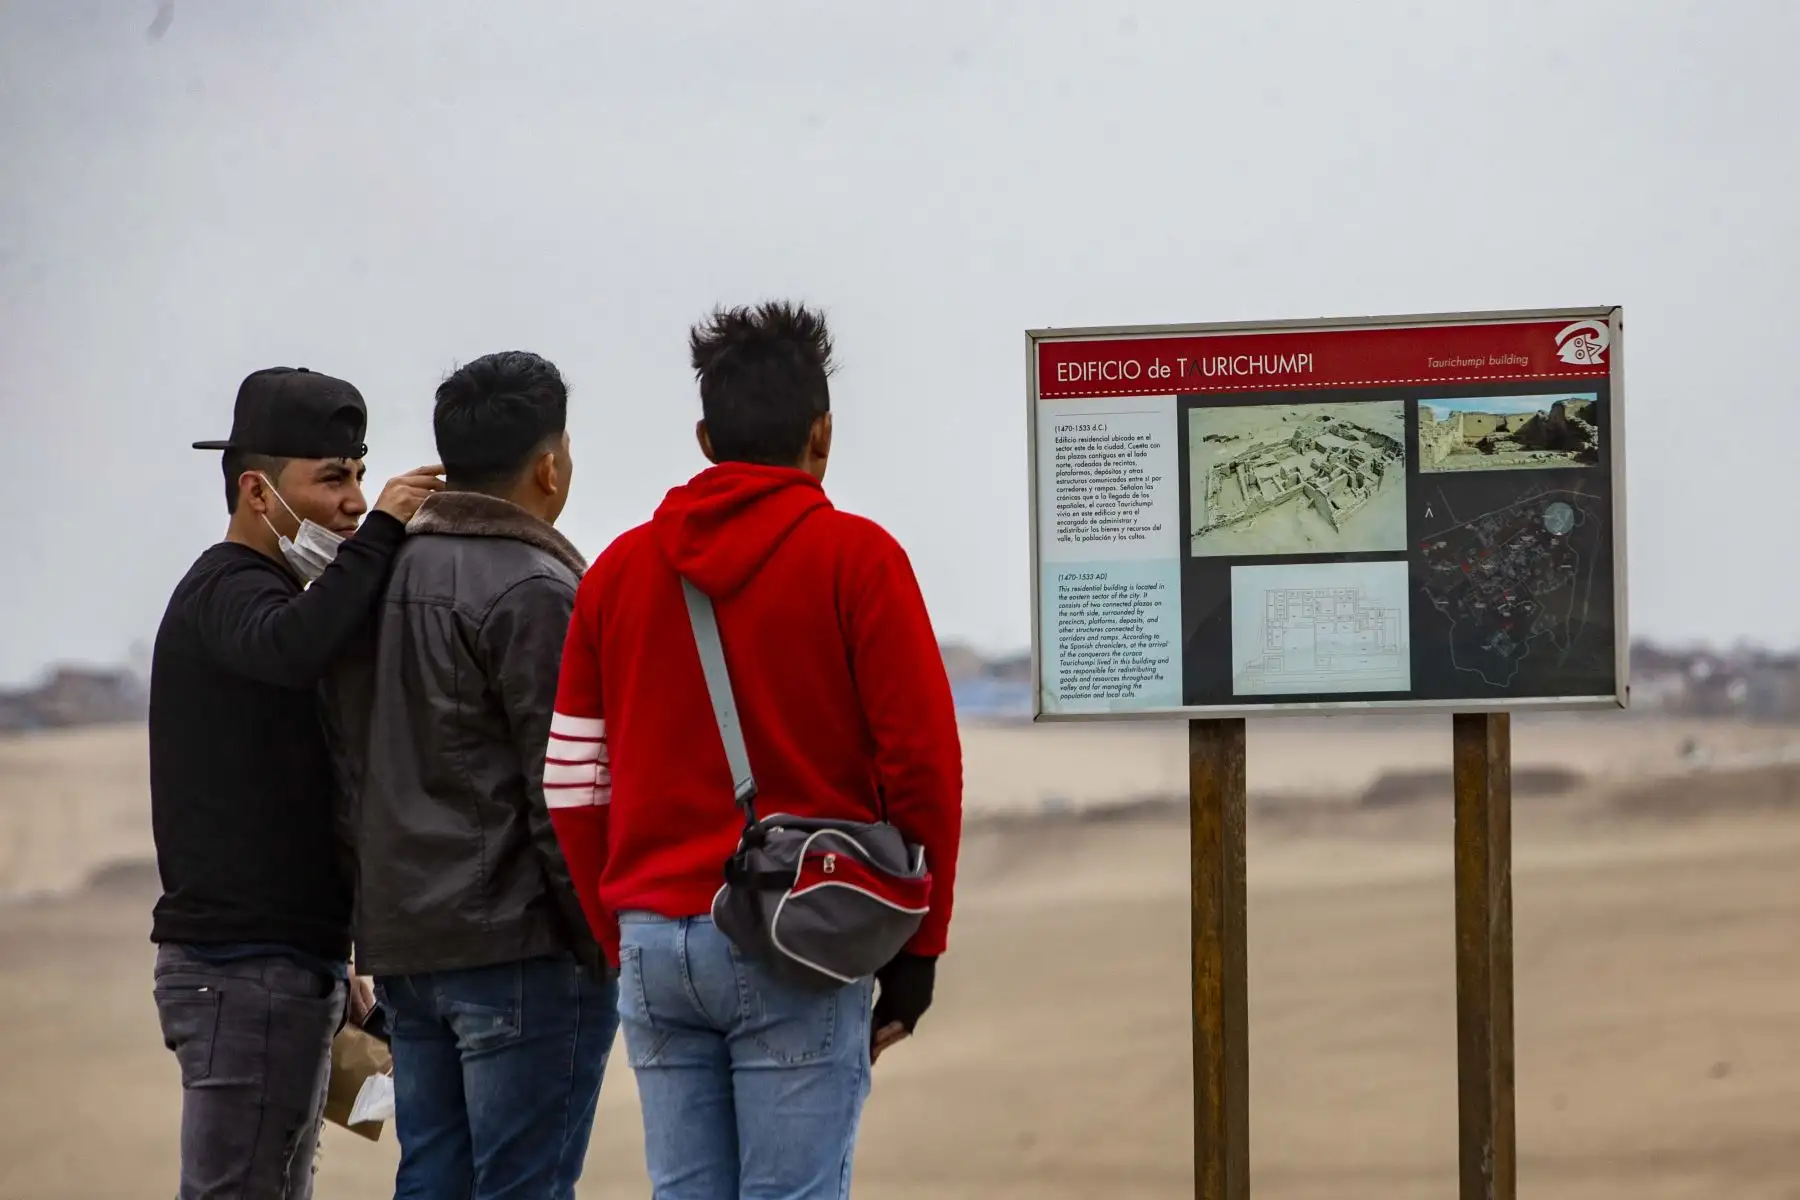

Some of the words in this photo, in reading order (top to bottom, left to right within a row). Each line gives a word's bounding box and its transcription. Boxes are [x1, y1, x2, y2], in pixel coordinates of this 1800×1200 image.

[1428, 356, 1485, 368] Taurichumpi
[1489, 354, 1528, 366] building
[1057, 360, 1141, 382] EDIFICIO
[1148, 358, 1171, 378] de
[1067, 453, 1087, 461] plazas
[1088, 451, 1116, 460] contiguas
[1056, 485, 1087, 493] corredores
[1108, 492, 1130, 500] llegada
[1057, 518, 1088, 526] encargado
[1099, 516, 1132, 524] administrar
[1118, 665, 1156, 673] redistributing
[1060, 676, 1078, 684] goods
[1121, 674, 1153, 682] throughout
